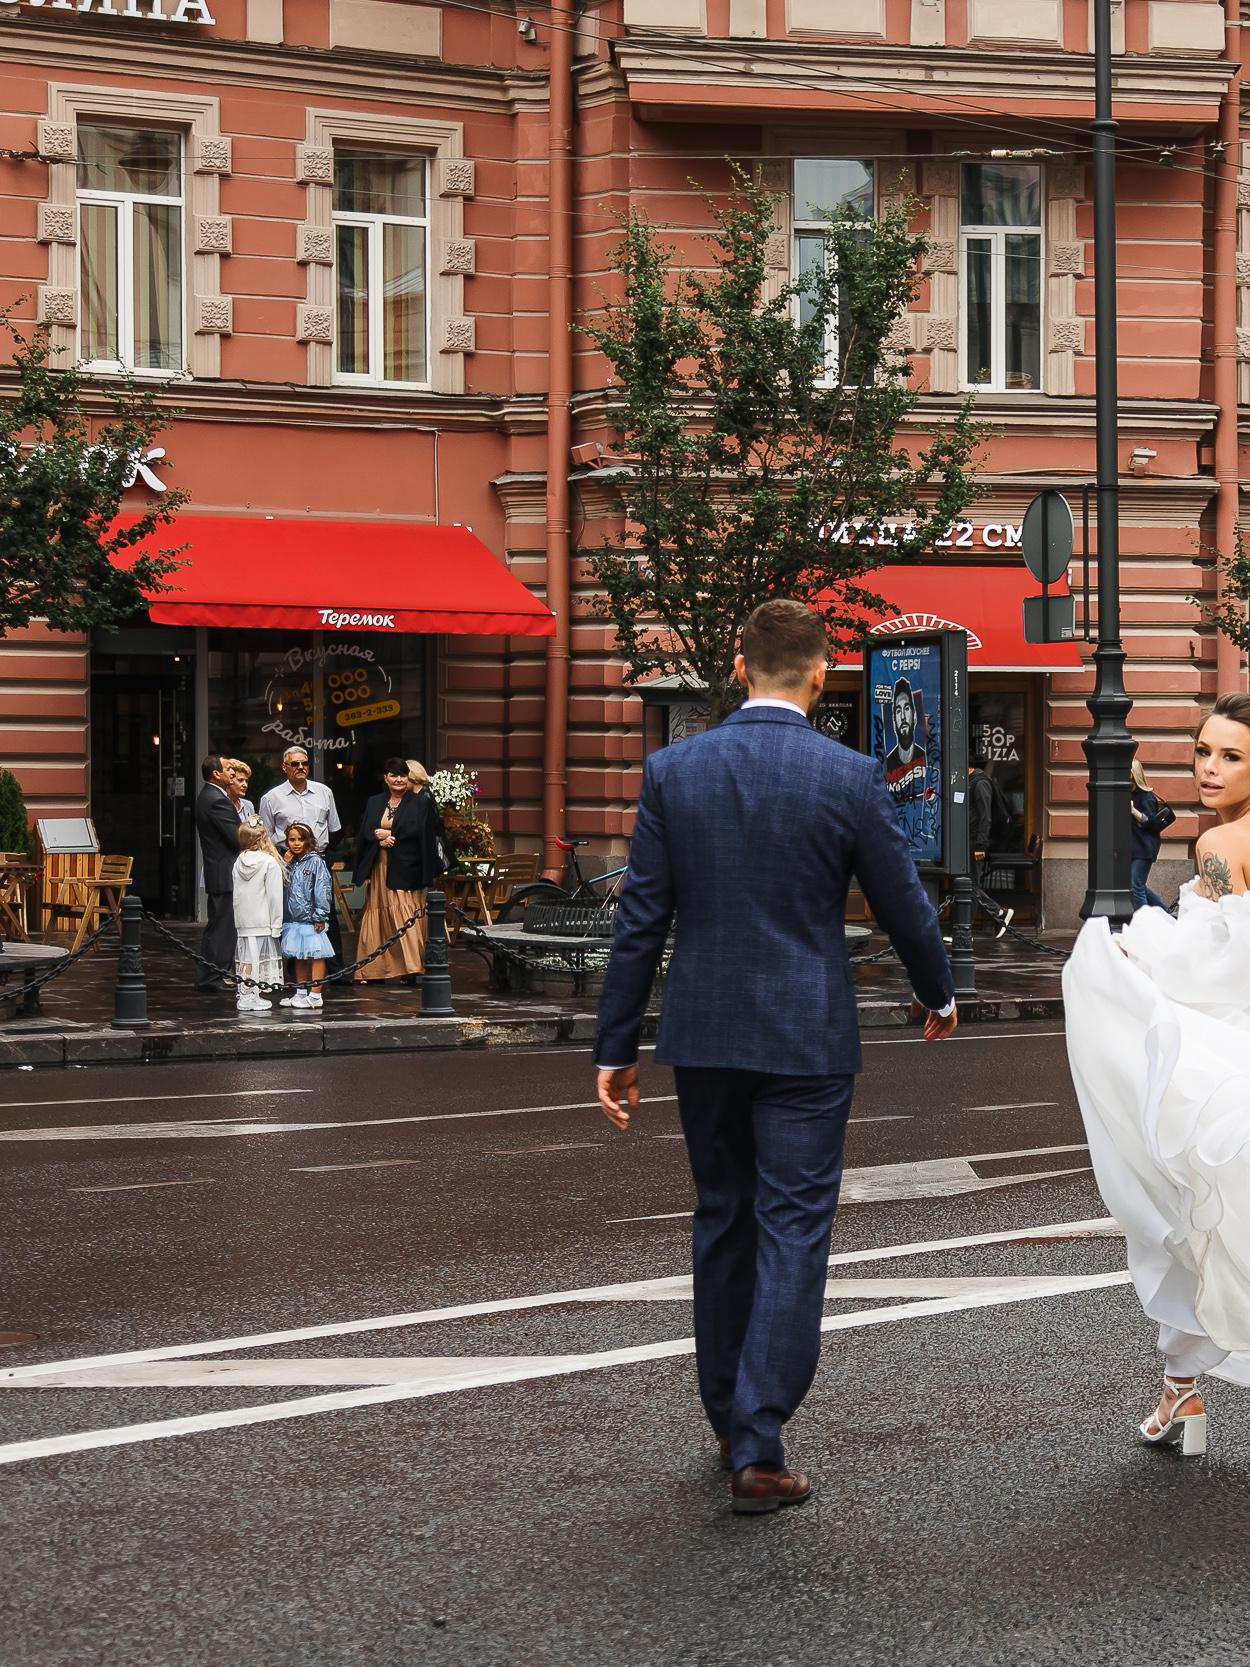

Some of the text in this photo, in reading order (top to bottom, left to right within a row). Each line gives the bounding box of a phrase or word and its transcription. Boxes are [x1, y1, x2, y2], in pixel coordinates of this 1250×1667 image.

[935, 522, 973, 546] 22
[318, 609, 395, 628] Теремок
[283, 643, 376, 672] Вкусная
[881, 646, 930, 658] ФУТБОЛ ВКУСНЕЕ
[899, 658, 921, 671] PEPSI
[982, 733, 1015, 747] TOP
